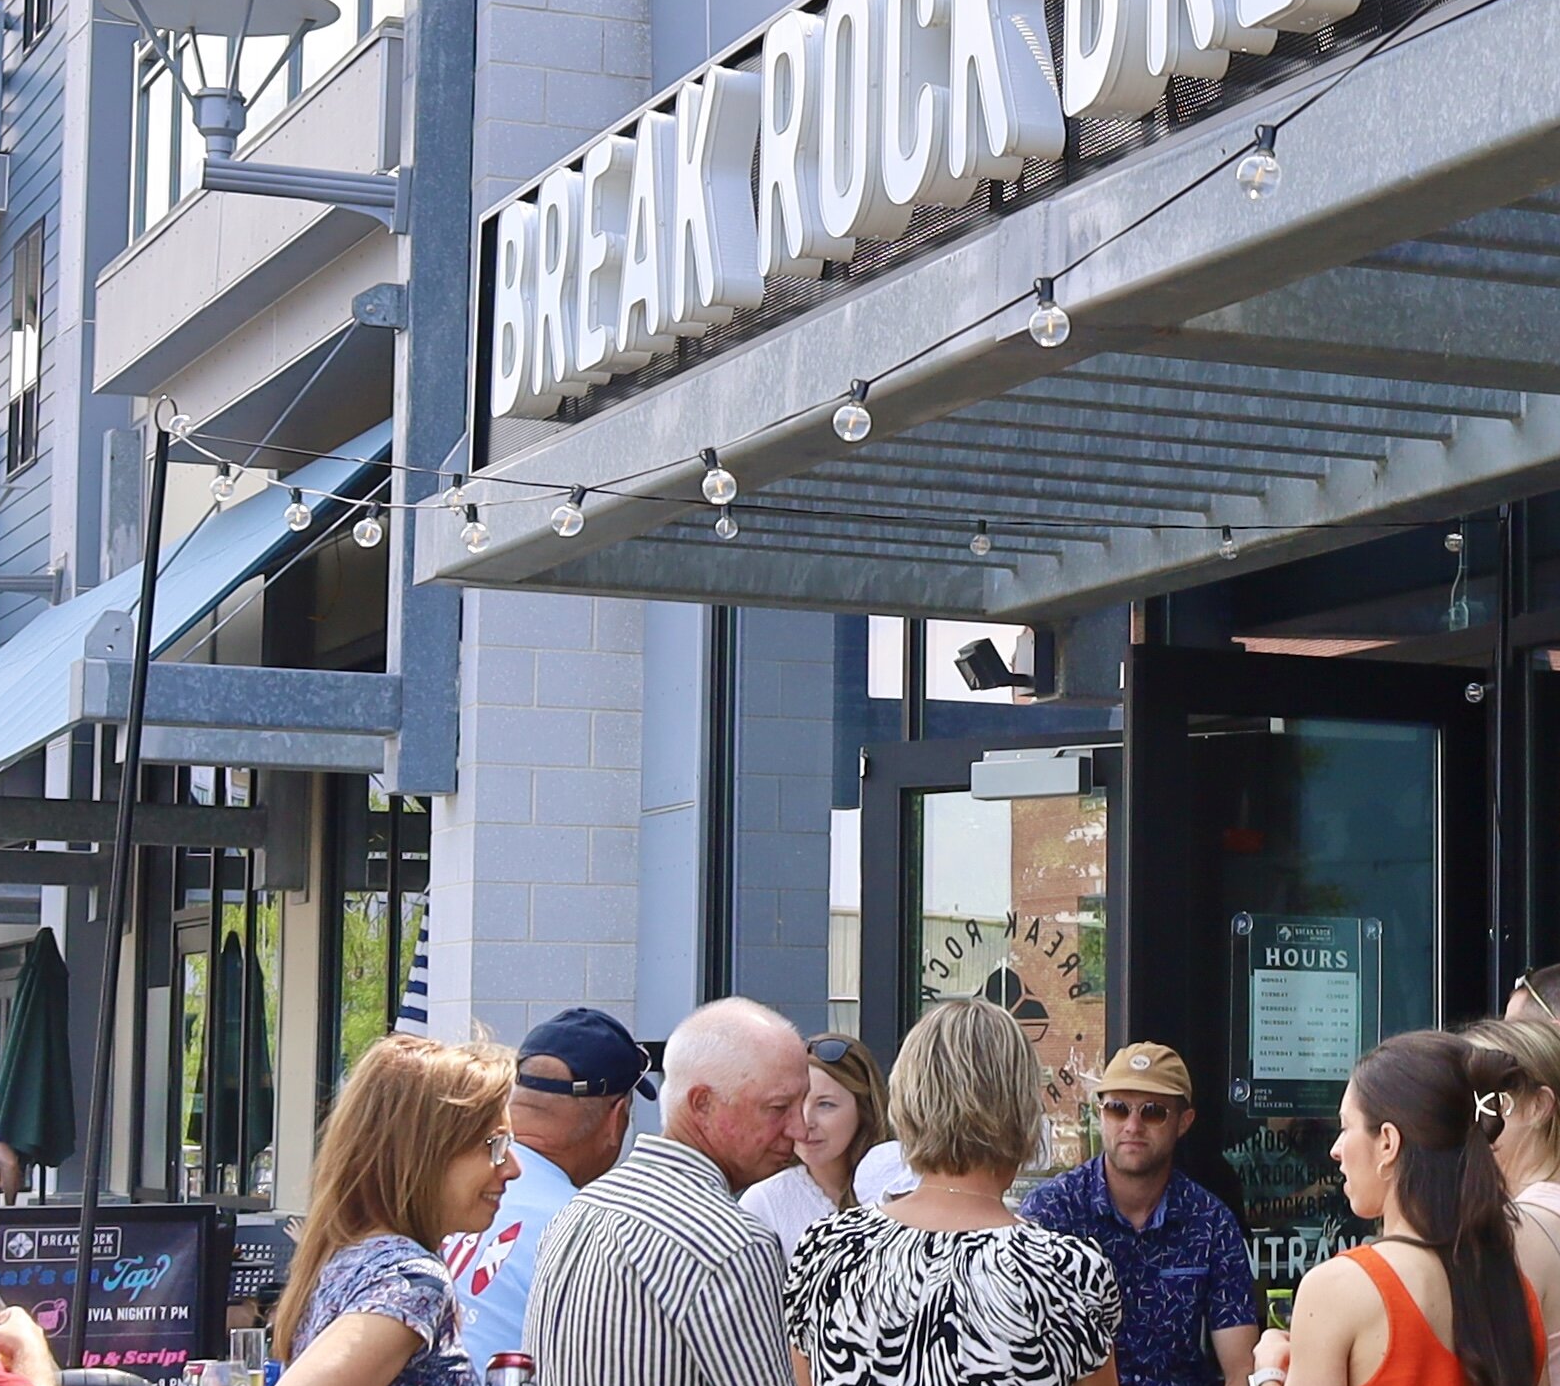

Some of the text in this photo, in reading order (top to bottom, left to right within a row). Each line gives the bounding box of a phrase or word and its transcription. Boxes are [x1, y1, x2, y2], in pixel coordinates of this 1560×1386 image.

[490, 61, 762, 421] BREAK
[1265, 947, 1349, 969] HOURS
[41, 1232, 114, 1246] BREAK OCK
[102, 1253, 171, 1303] Tap?
[87, 1307, 113, 1323] IVIA
[160, 1306, 167, 1320] 7
[170, 1305, 189, 1320] PM
[82, 1347, 188, 1368] ip & Script
